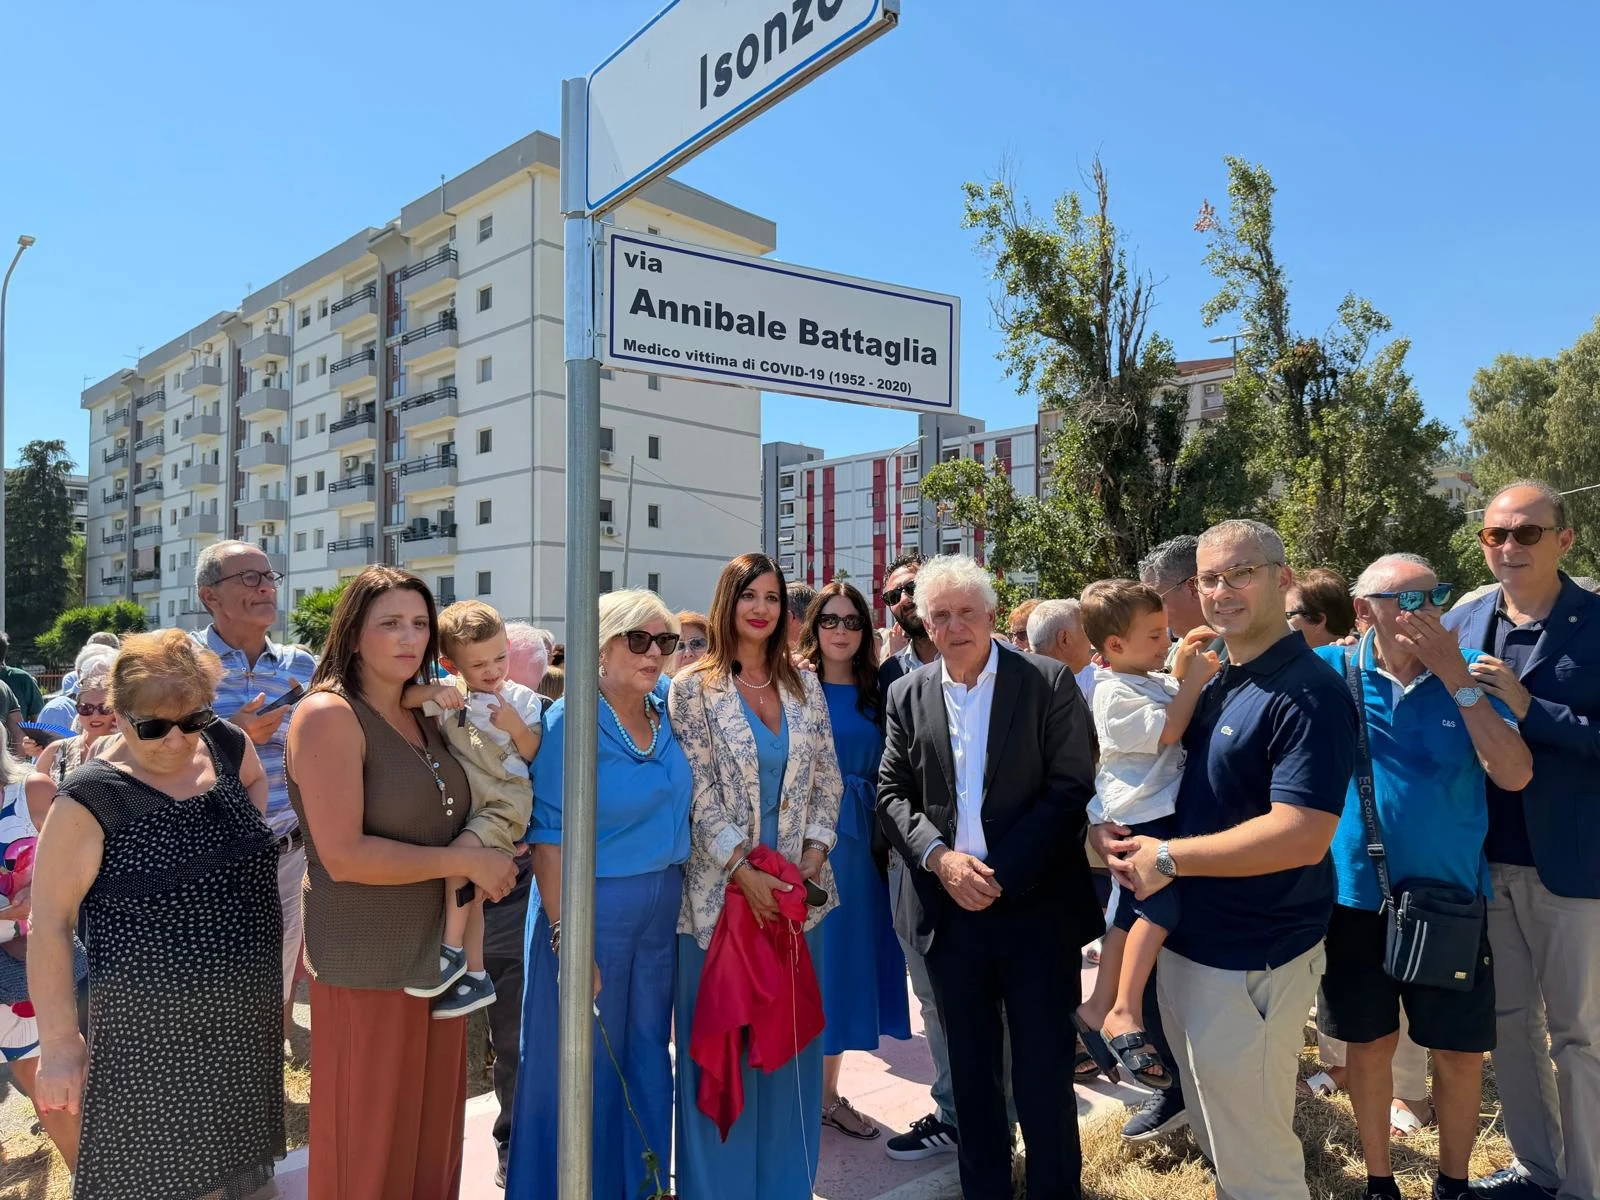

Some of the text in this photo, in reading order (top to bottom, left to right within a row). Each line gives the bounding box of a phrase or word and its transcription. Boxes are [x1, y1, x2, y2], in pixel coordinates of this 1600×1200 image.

[624, 250, 663, 273] via
[629, 287, 937, 366] Annibale Battaglia
[623, 338, 681, 359] Medico
[685, 349, 738, 372] vittima
[742, 358, 755, 371] di
[759, 360, 825, 381] COVID-19
[829, 371, 866, 387] (1952
[877, 377, 912, 396] 2020)
